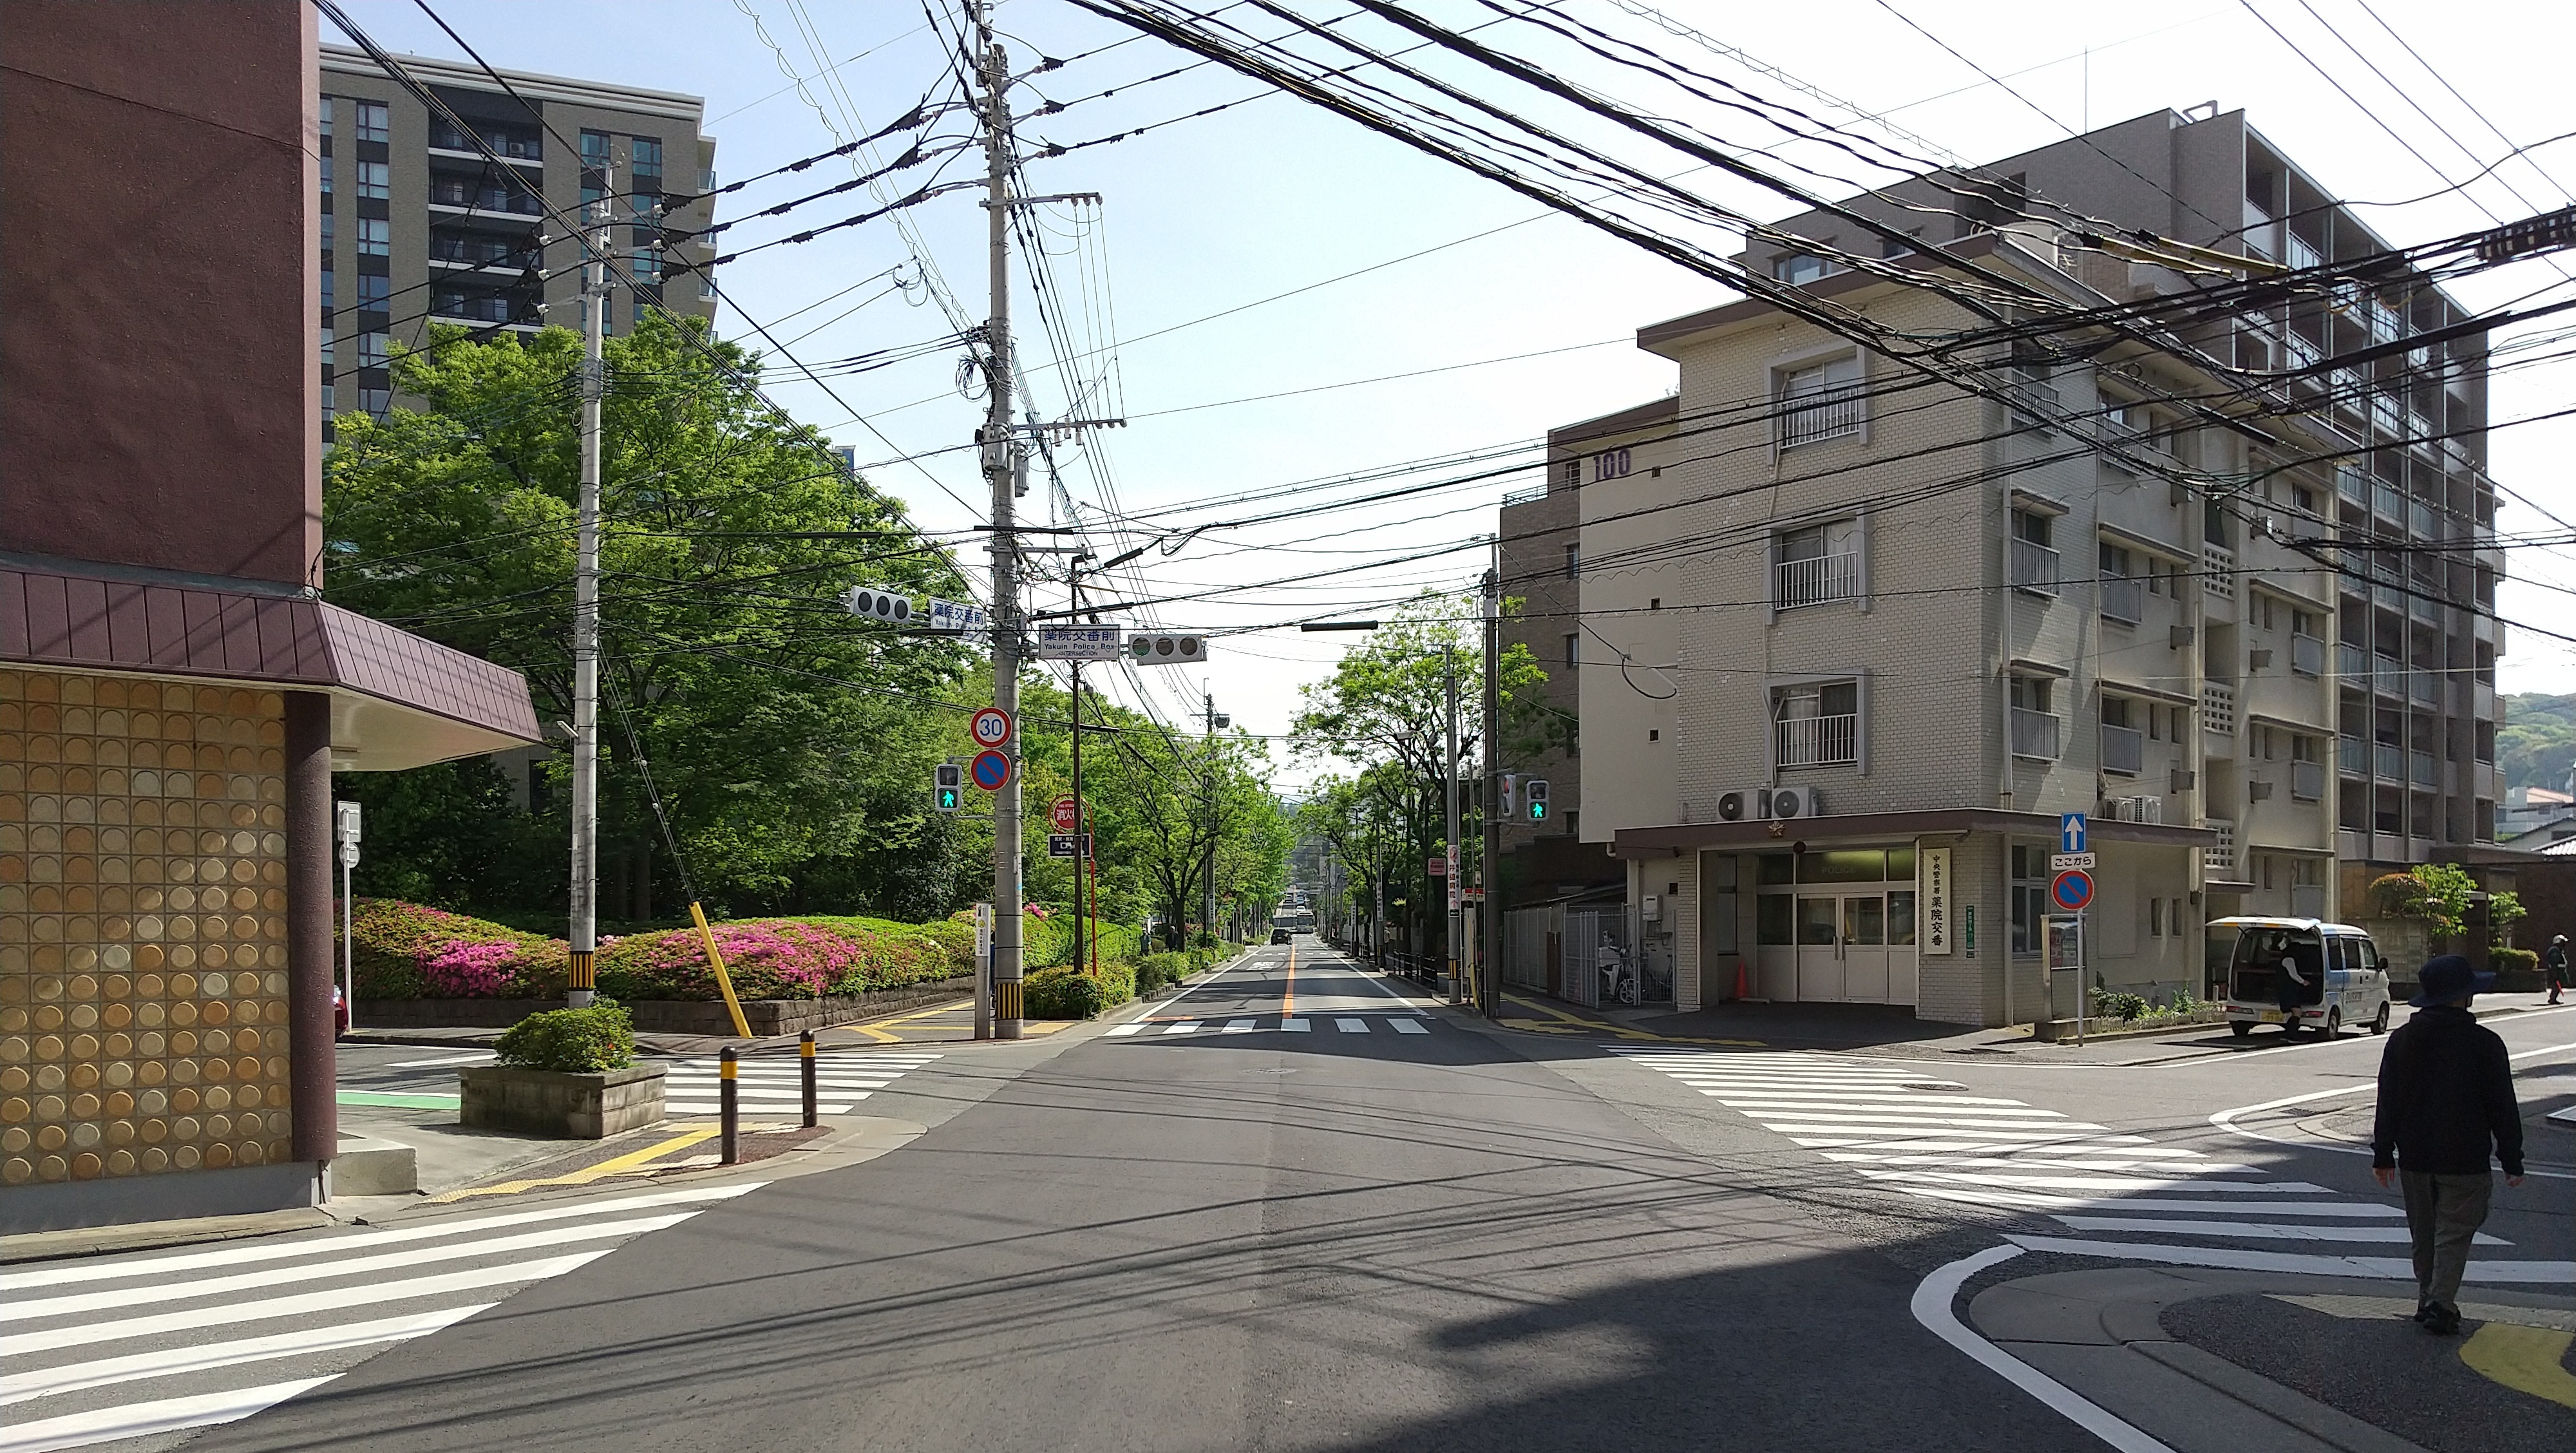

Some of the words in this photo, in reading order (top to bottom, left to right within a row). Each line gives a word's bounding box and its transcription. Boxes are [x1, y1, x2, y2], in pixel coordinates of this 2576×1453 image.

[1593, 448, 1631, 481] 100
[934, 603, 983, 625] 薬院交番前
[1044, 629, 1115, 641] 薬院交番前
[980, 719, 1002, 736] 30
[2055, 857, 2092, 866] ここから
